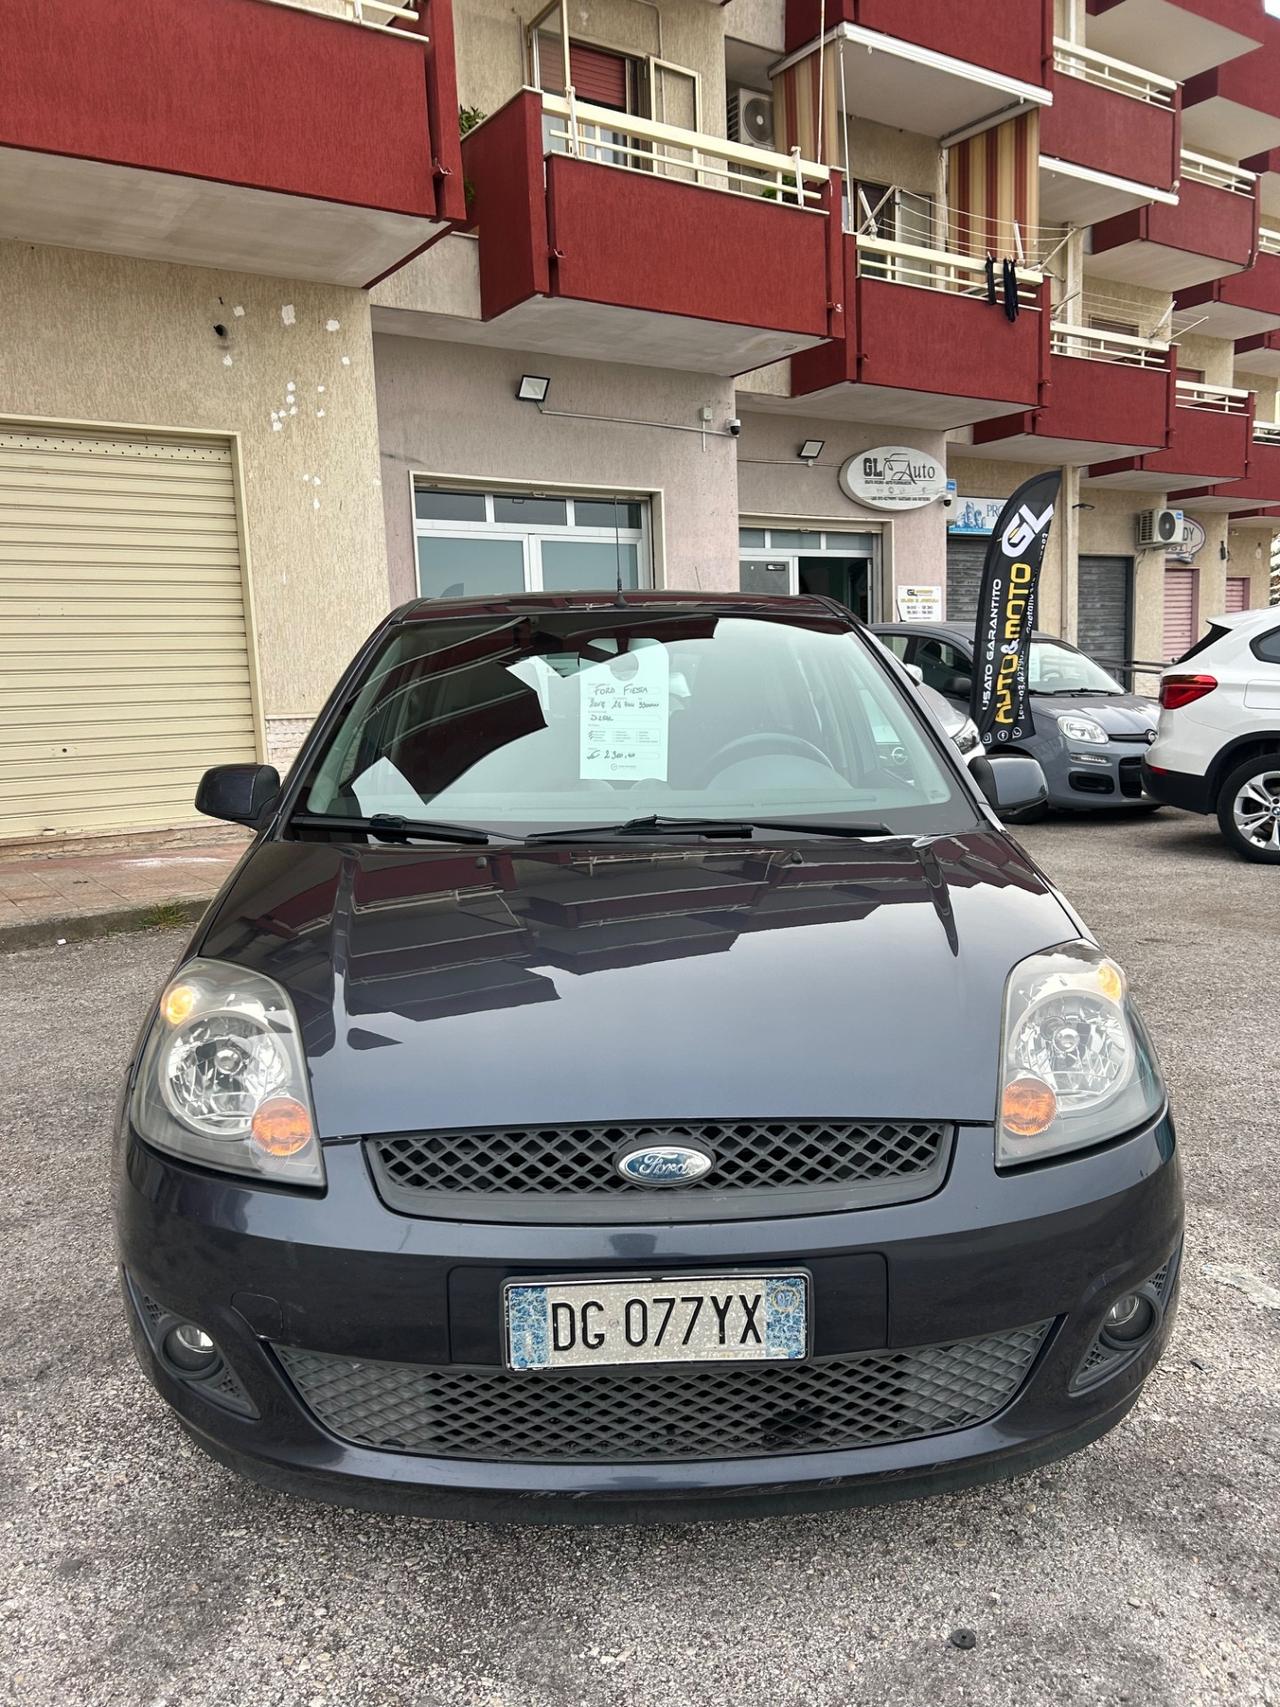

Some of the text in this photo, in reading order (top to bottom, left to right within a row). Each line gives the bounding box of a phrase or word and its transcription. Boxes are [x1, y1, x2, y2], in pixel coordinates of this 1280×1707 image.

[863, 458, 882, 477] GL
[1001, 504, 1055, 557] GL
[982, 578, 1002, 710] USATO GARANTITO
[639, 1152, 692, 1175] Ford
[551, 1294, 763, 1351] DG 077YX
